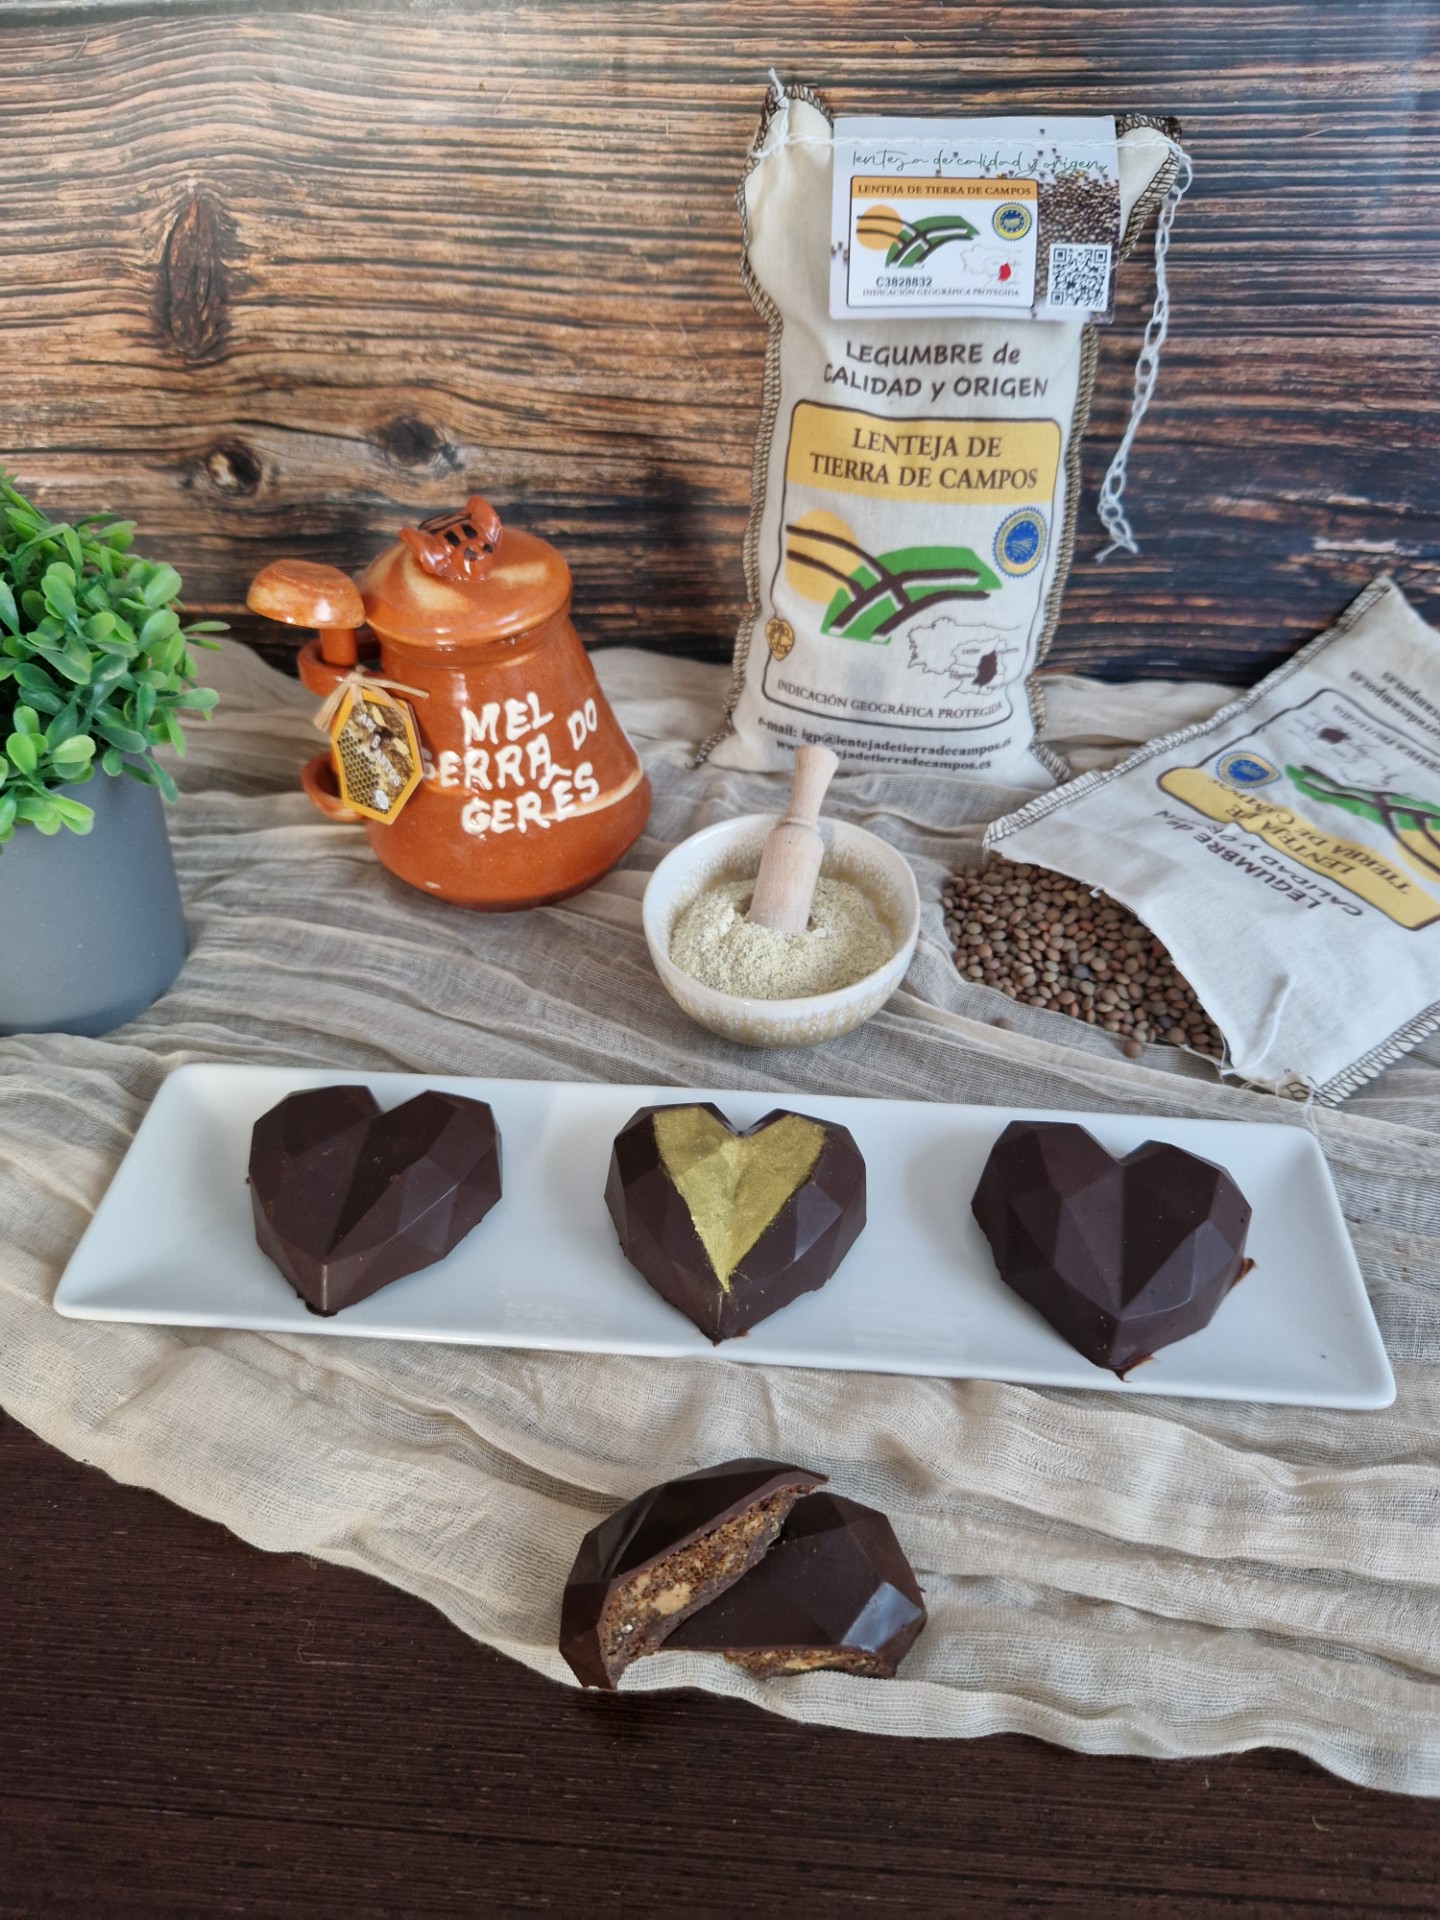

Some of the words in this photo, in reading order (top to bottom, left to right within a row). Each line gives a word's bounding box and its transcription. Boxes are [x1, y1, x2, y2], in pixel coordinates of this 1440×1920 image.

[933, 149, 953, 169] de
[957, 150, 1022, 170] calidad
[1043, 157, 1107, 179] origen
[858, 185, 904, 196] LENTEJA
[907, 186, 922, 194] DE
[925, 186, 965, 195] TIERRA
[967, 187, 982, 195] DE
[984, 187, 1031, 196] CAMPOS
[876, 277, 933, 287] C3828832
[846, 341, 983, 367] LEGUMBRE
[992, 342, 1021, 365] de
[823, 364, 922, 397] CALIDAD
[931, 381, 945, 402] y
[953, 377, 1049, 398] ORIGEN
[851, 428, 959, 461] LENTEJA
[967, 436, 1002, 458] DE
[809, 452, 889, 485] TIERRA
[898, 467, 931, 488] DE
[938, 468, 1037, 490] CAMPOS
[777, 679, 848, 708] INDICACIÓN
[850, 700, 934, 718] GEOGRÁFICA
[937, 700, 1003, 719] PROTEGIDA
[461, 692, 554, 746] MEL
[567, 698, 597, 751] DO
[758, 717, 797, 738] e-mail:
[801, 728, 1011, 757] igp@lentejadetierradecampos.es
[1261, 820, 1356, 875] LENTEJA
[1294, 827, 1328, 846] DE
[1193, 833, 1322, 909] LEGUMBRE
[1260, 855, 1364, 916] CALIDAD
[1331, 845, 1411, 894] TIERRA
